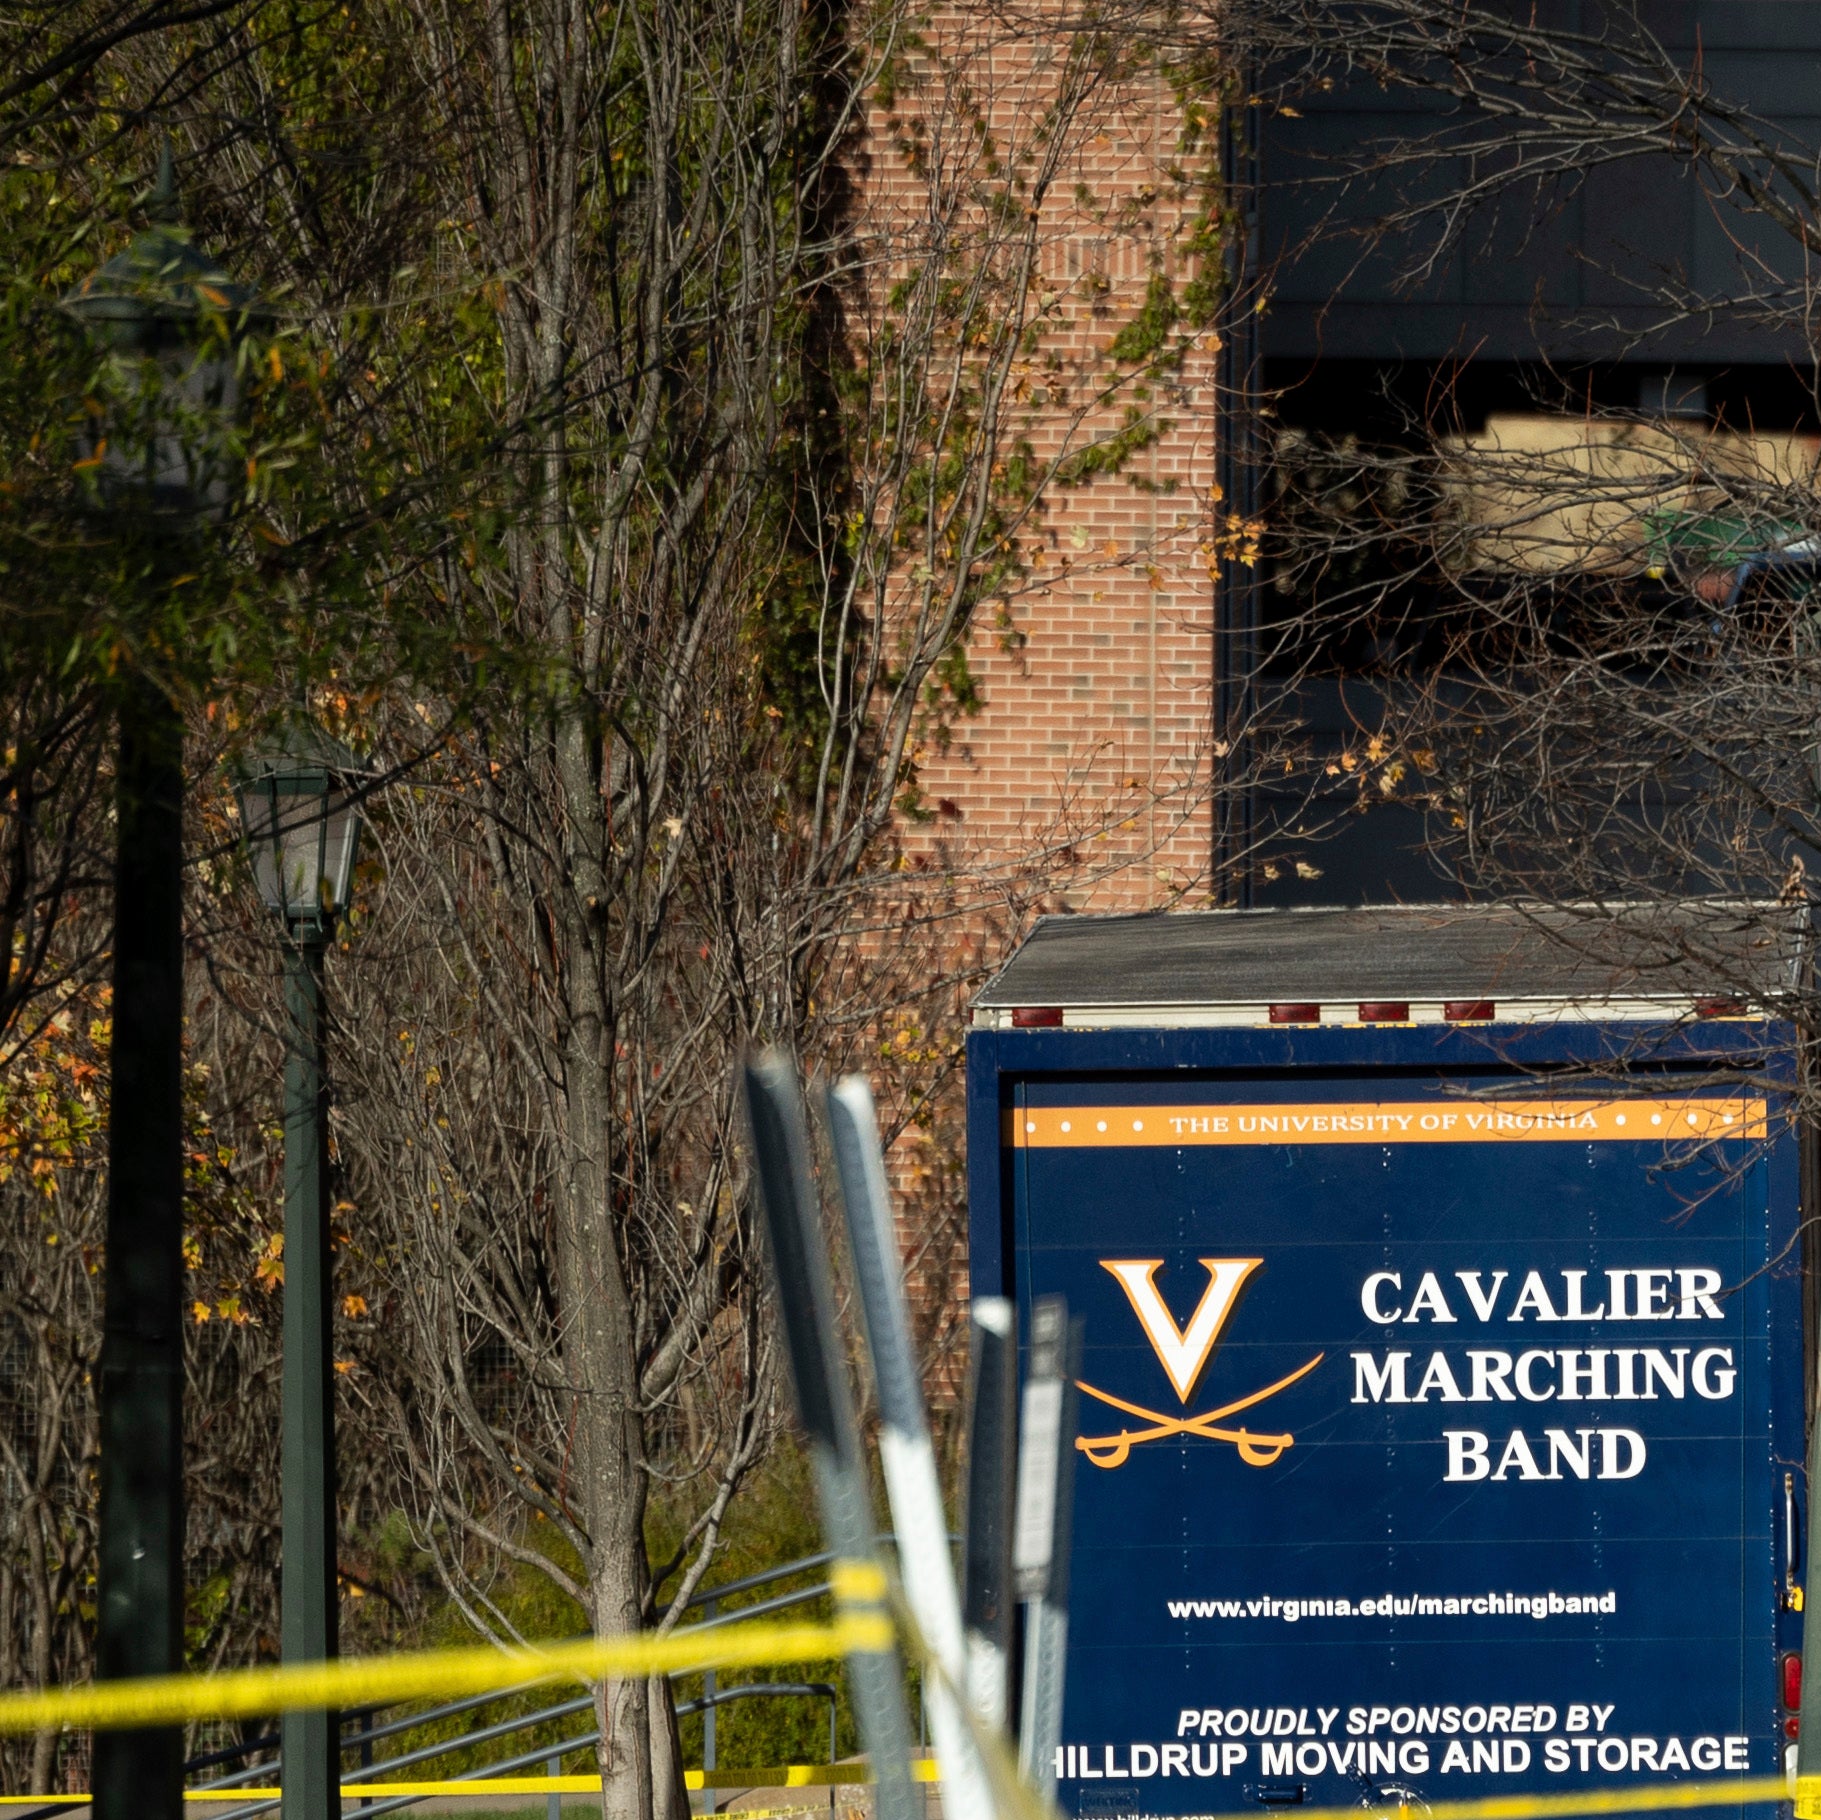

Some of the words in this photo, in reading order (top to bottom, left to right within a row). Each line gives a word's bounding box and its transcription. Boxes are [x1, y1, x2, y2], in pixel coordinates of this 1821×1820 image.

[1168, 1116, 1229, 1134] THE
[1237, 1114, 1413, 1132] UNIVERSITY
[1419, 1113, 1458, 1131] OF
[1465, 1111, 1599, 1130] VIRGINIA
[1359, 1267, 1725, 1324] CAVALIER
[1349, 1347, 1738, 1404] MARCHING
[1442, 1428, 1647, 1483] BAND
[1167, 1592, 1617, 1622] www.virginia.edu/marchingband
[1177, 1707, 1340, 1737] PROUDLY
[1345, 1705, 1558, 1735] SPONSORED
[1565, 1704, 1616, 1732] BY
[1261, 1739, 1430, 1776] MOVING
[1440, 1738, 1531, 1774] AND
[1543, 1736, 1750, 1773] STORAGE
